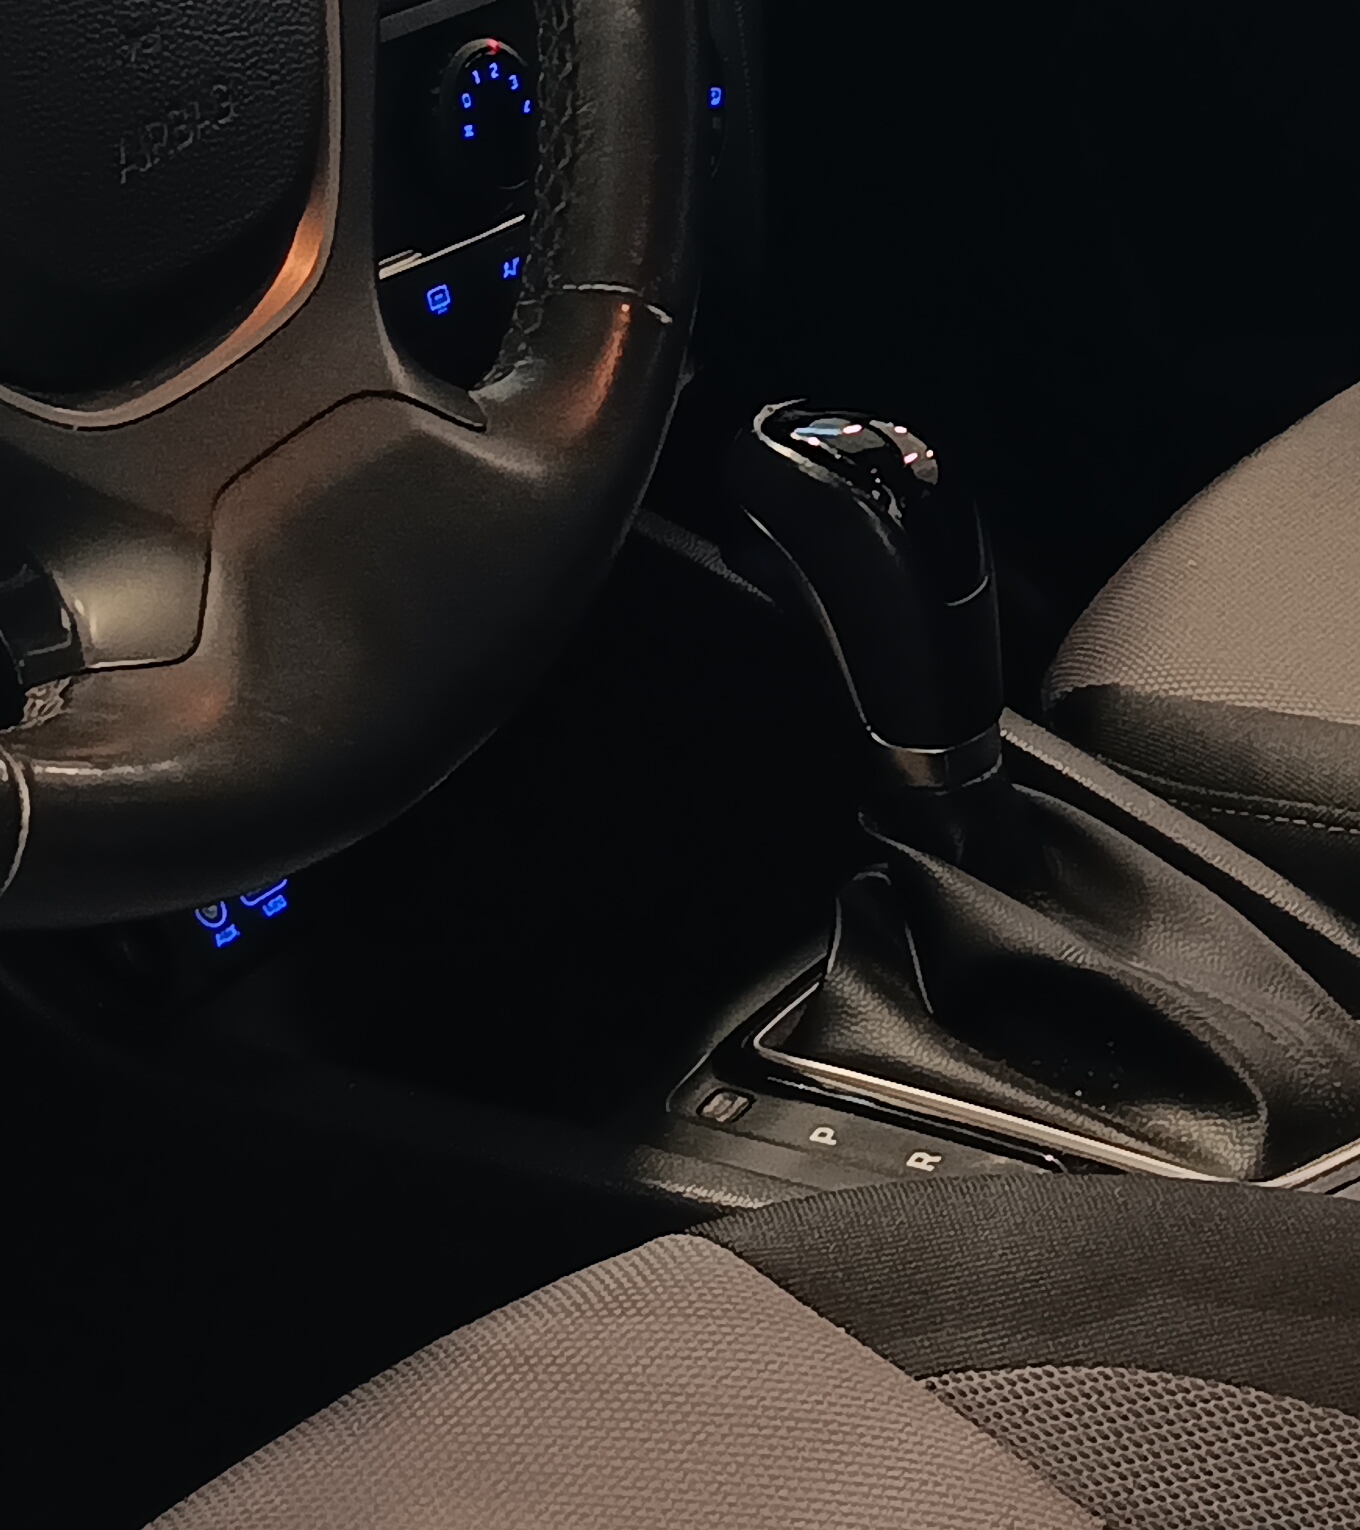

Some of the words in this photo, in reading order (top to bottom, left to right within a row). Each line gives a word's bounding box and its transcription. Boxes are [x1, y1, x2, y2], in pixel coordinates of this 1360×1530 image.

[488, 62, 500, 79] 2
[508, 74, 520, 91] 3
[809, 1126, 837, 1146] P
[905, 1151, 942, 1172] R
